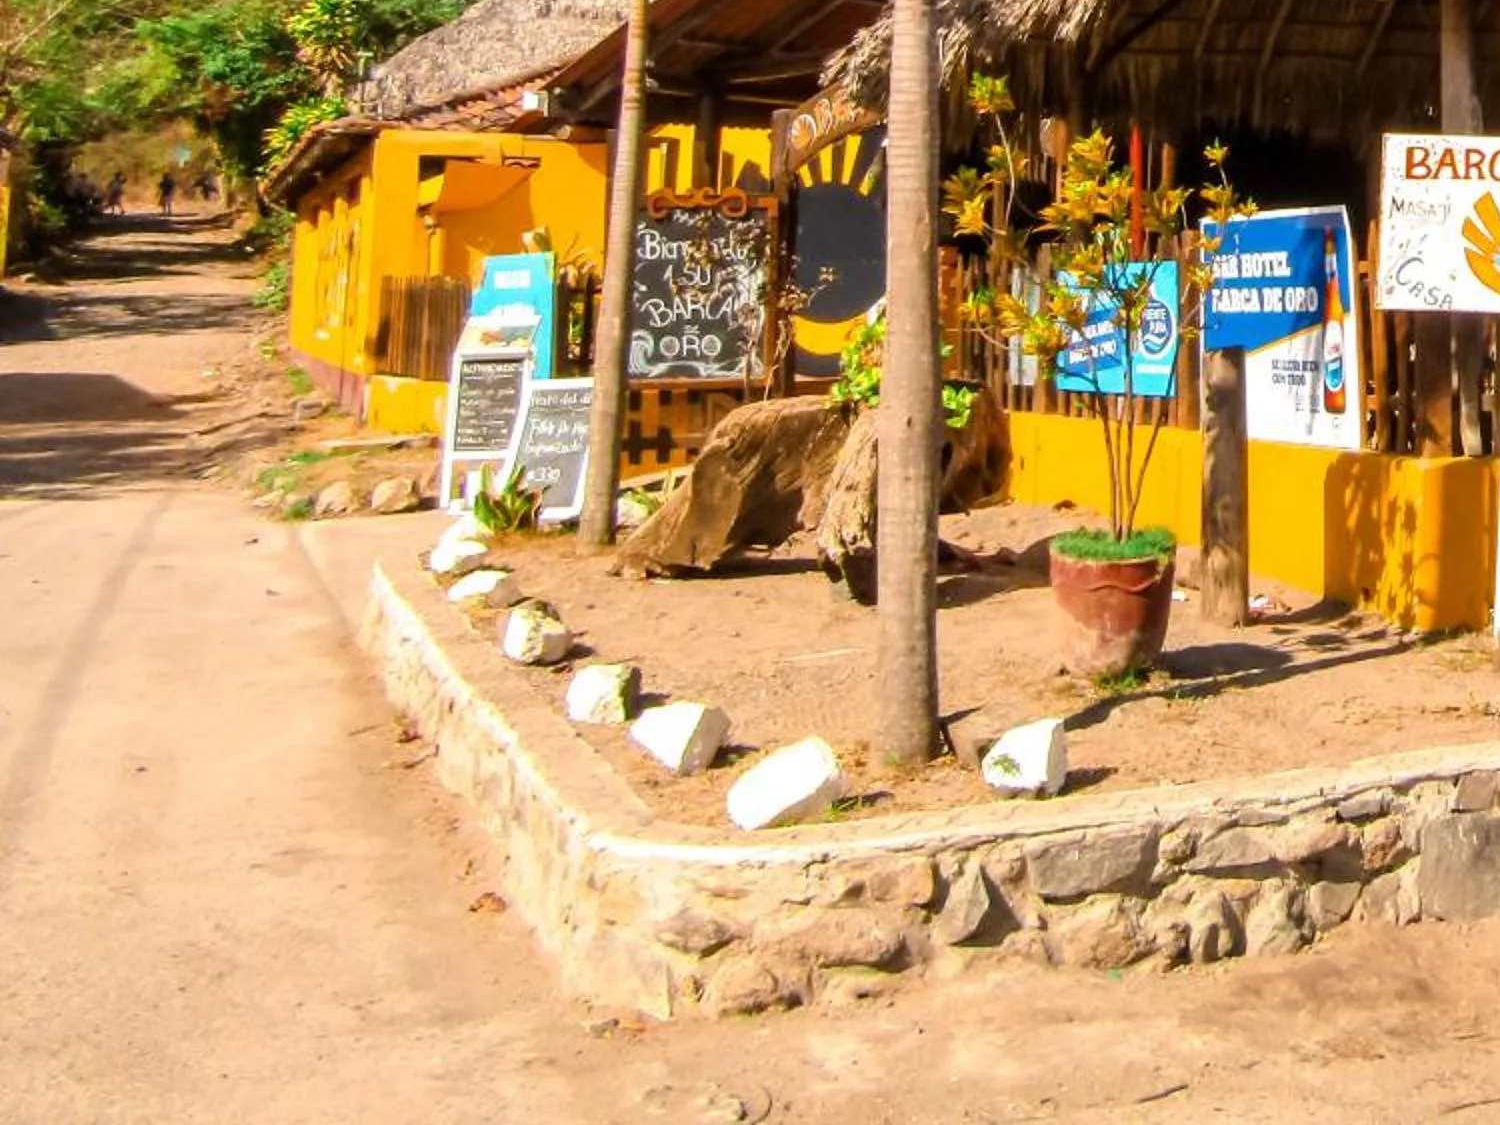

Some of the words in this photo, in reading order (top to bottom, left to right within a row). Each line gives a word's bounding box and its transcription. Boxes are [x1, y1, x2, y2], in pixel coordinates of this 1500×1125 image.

[1394, 256, 1454, 310] CASA
[639, 294, 736, 327] BARCA
[1262, 287, 1283, 312] DE
[1285, 286, 1319, 312] ORO
[659, 334, 722, 357] ORO
